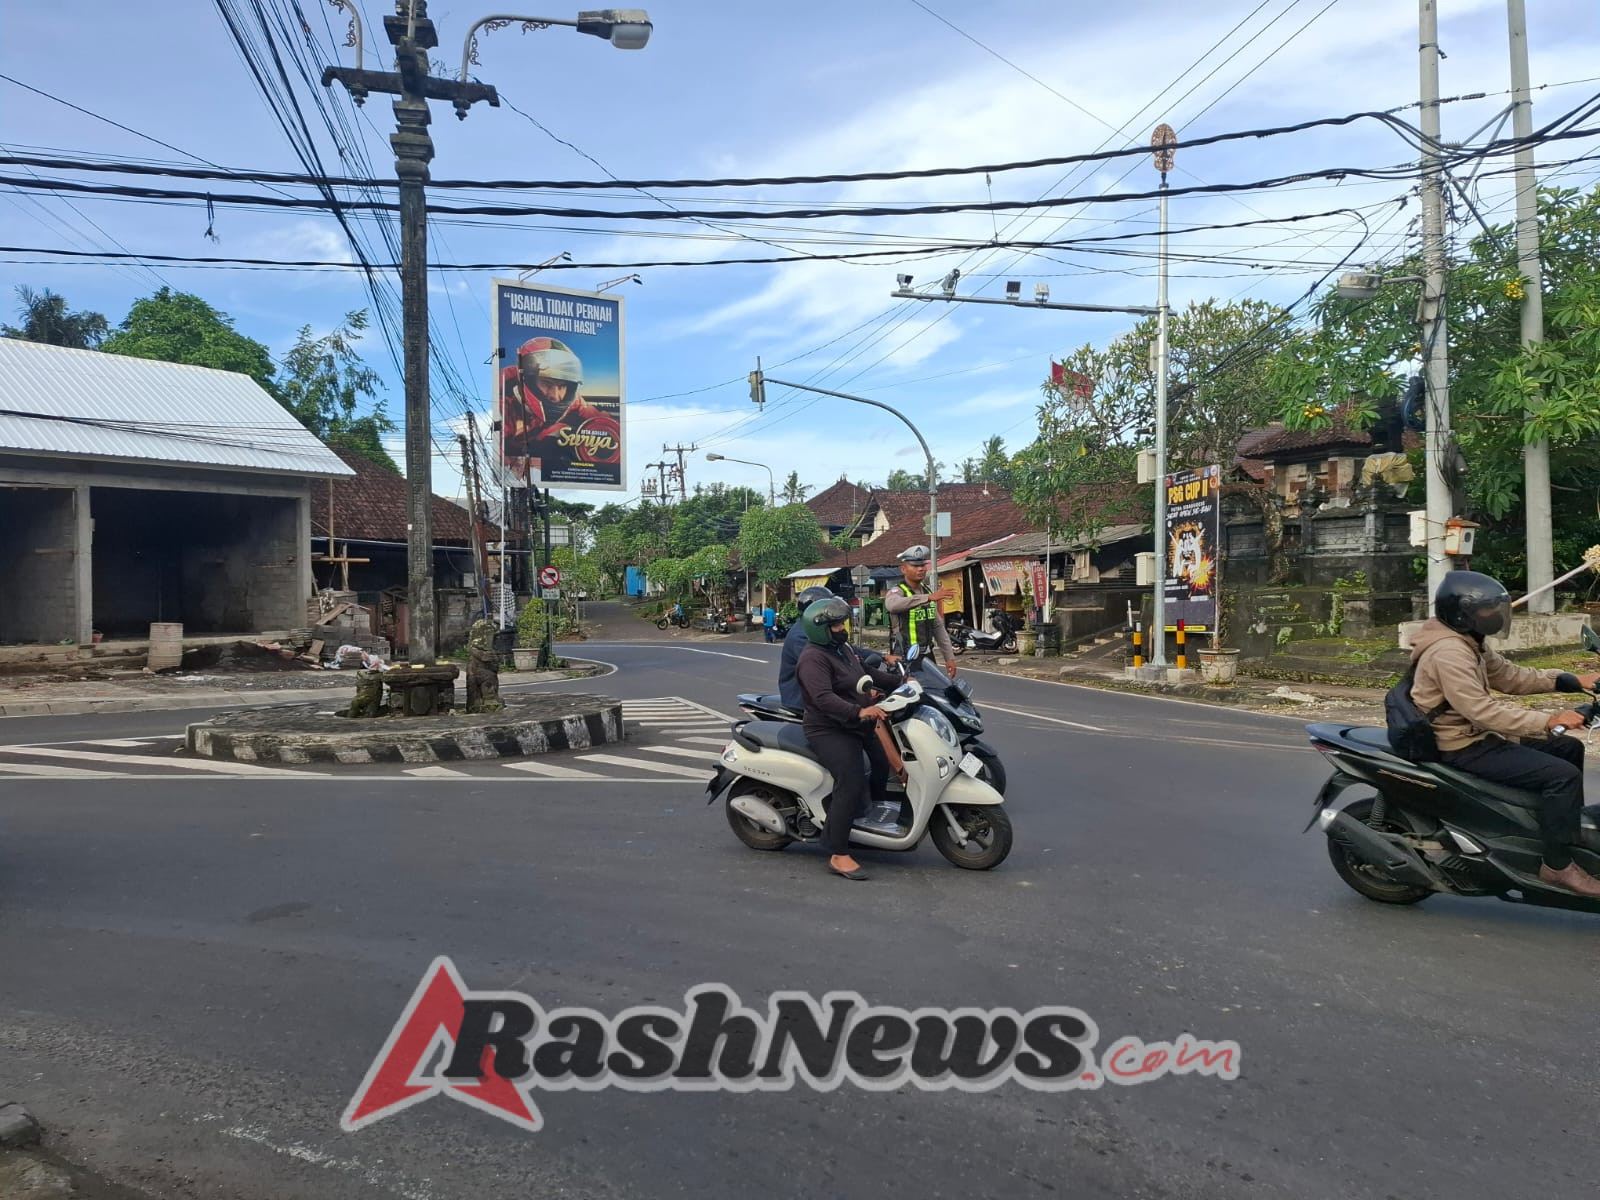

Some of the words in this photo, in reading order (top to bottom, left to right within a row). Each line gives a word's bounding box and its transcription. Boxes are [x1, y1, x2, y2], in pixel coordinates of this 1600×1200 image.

[511, 311, 572, 332] MENGKHIANATI
[546, 298, 574, 317] TIDAK
[576, 303, 612, 322] PERNAH
[557, 427, 618, 457] Surya
[1168, 484, 1184, 505] PSG
[1185, 481, 1201, 501] CUP
